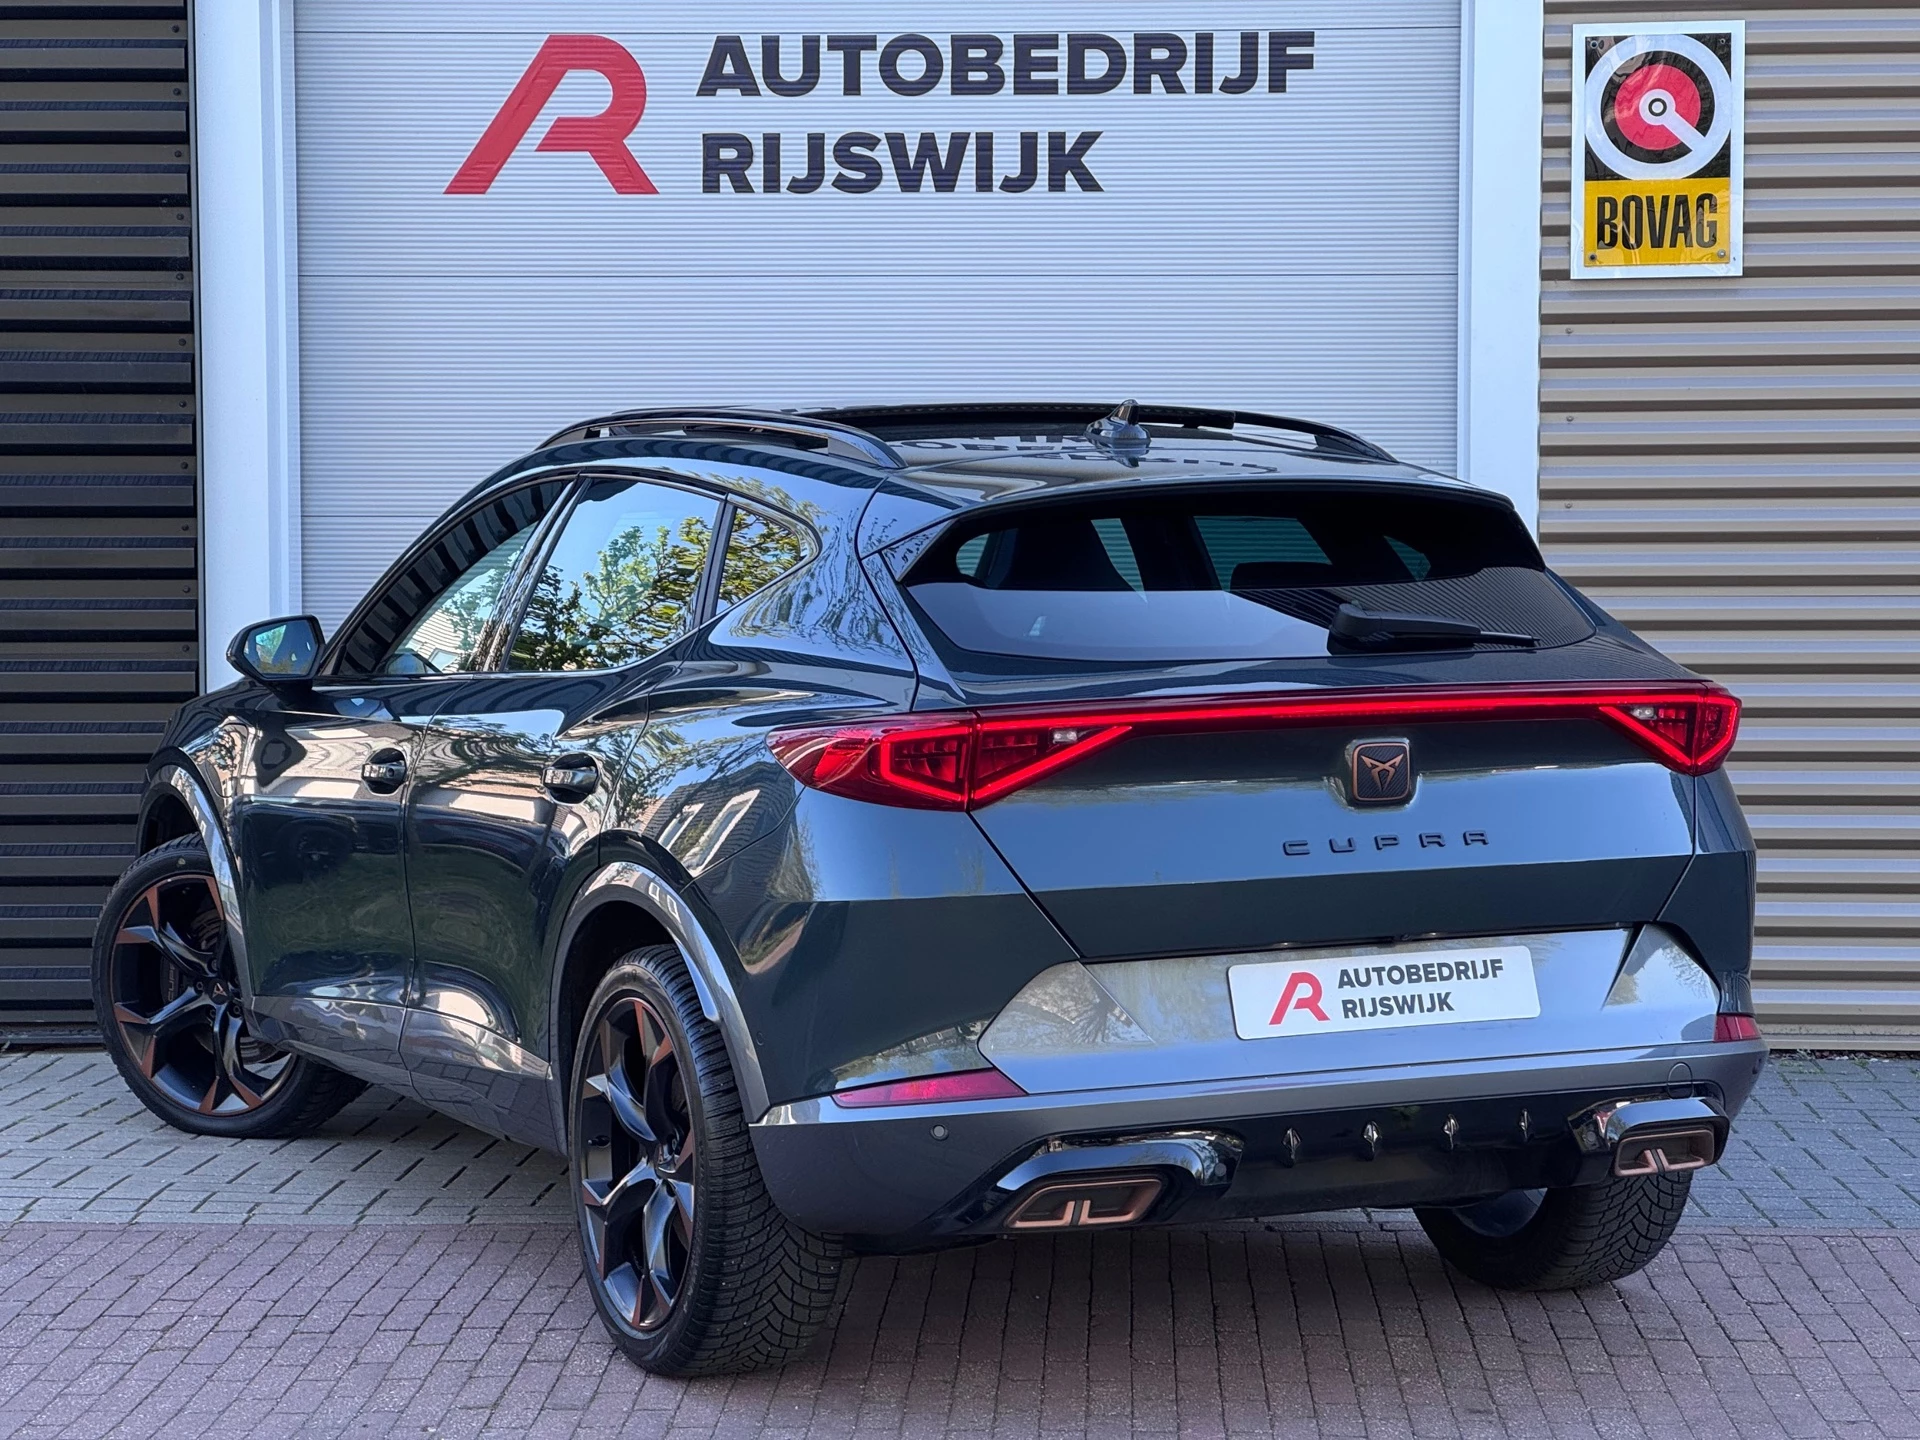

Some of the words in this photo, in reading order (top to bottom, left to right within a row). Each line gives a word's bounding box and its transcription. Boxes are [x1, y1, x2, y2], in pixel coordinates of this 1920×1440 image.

[696, 31, 1315, 98] AUTOBEDRIJF
[702, 131, 1104, 194] RIJSWIJK
[1597, 193, 1718, 250] BOVAG
[1282, 829, 1489, 857] CUPRA
[1338, 958, 1504, 989] AUTOBEDRIJF
[1342, 991, 1455, 1019] RIJSWIJK
